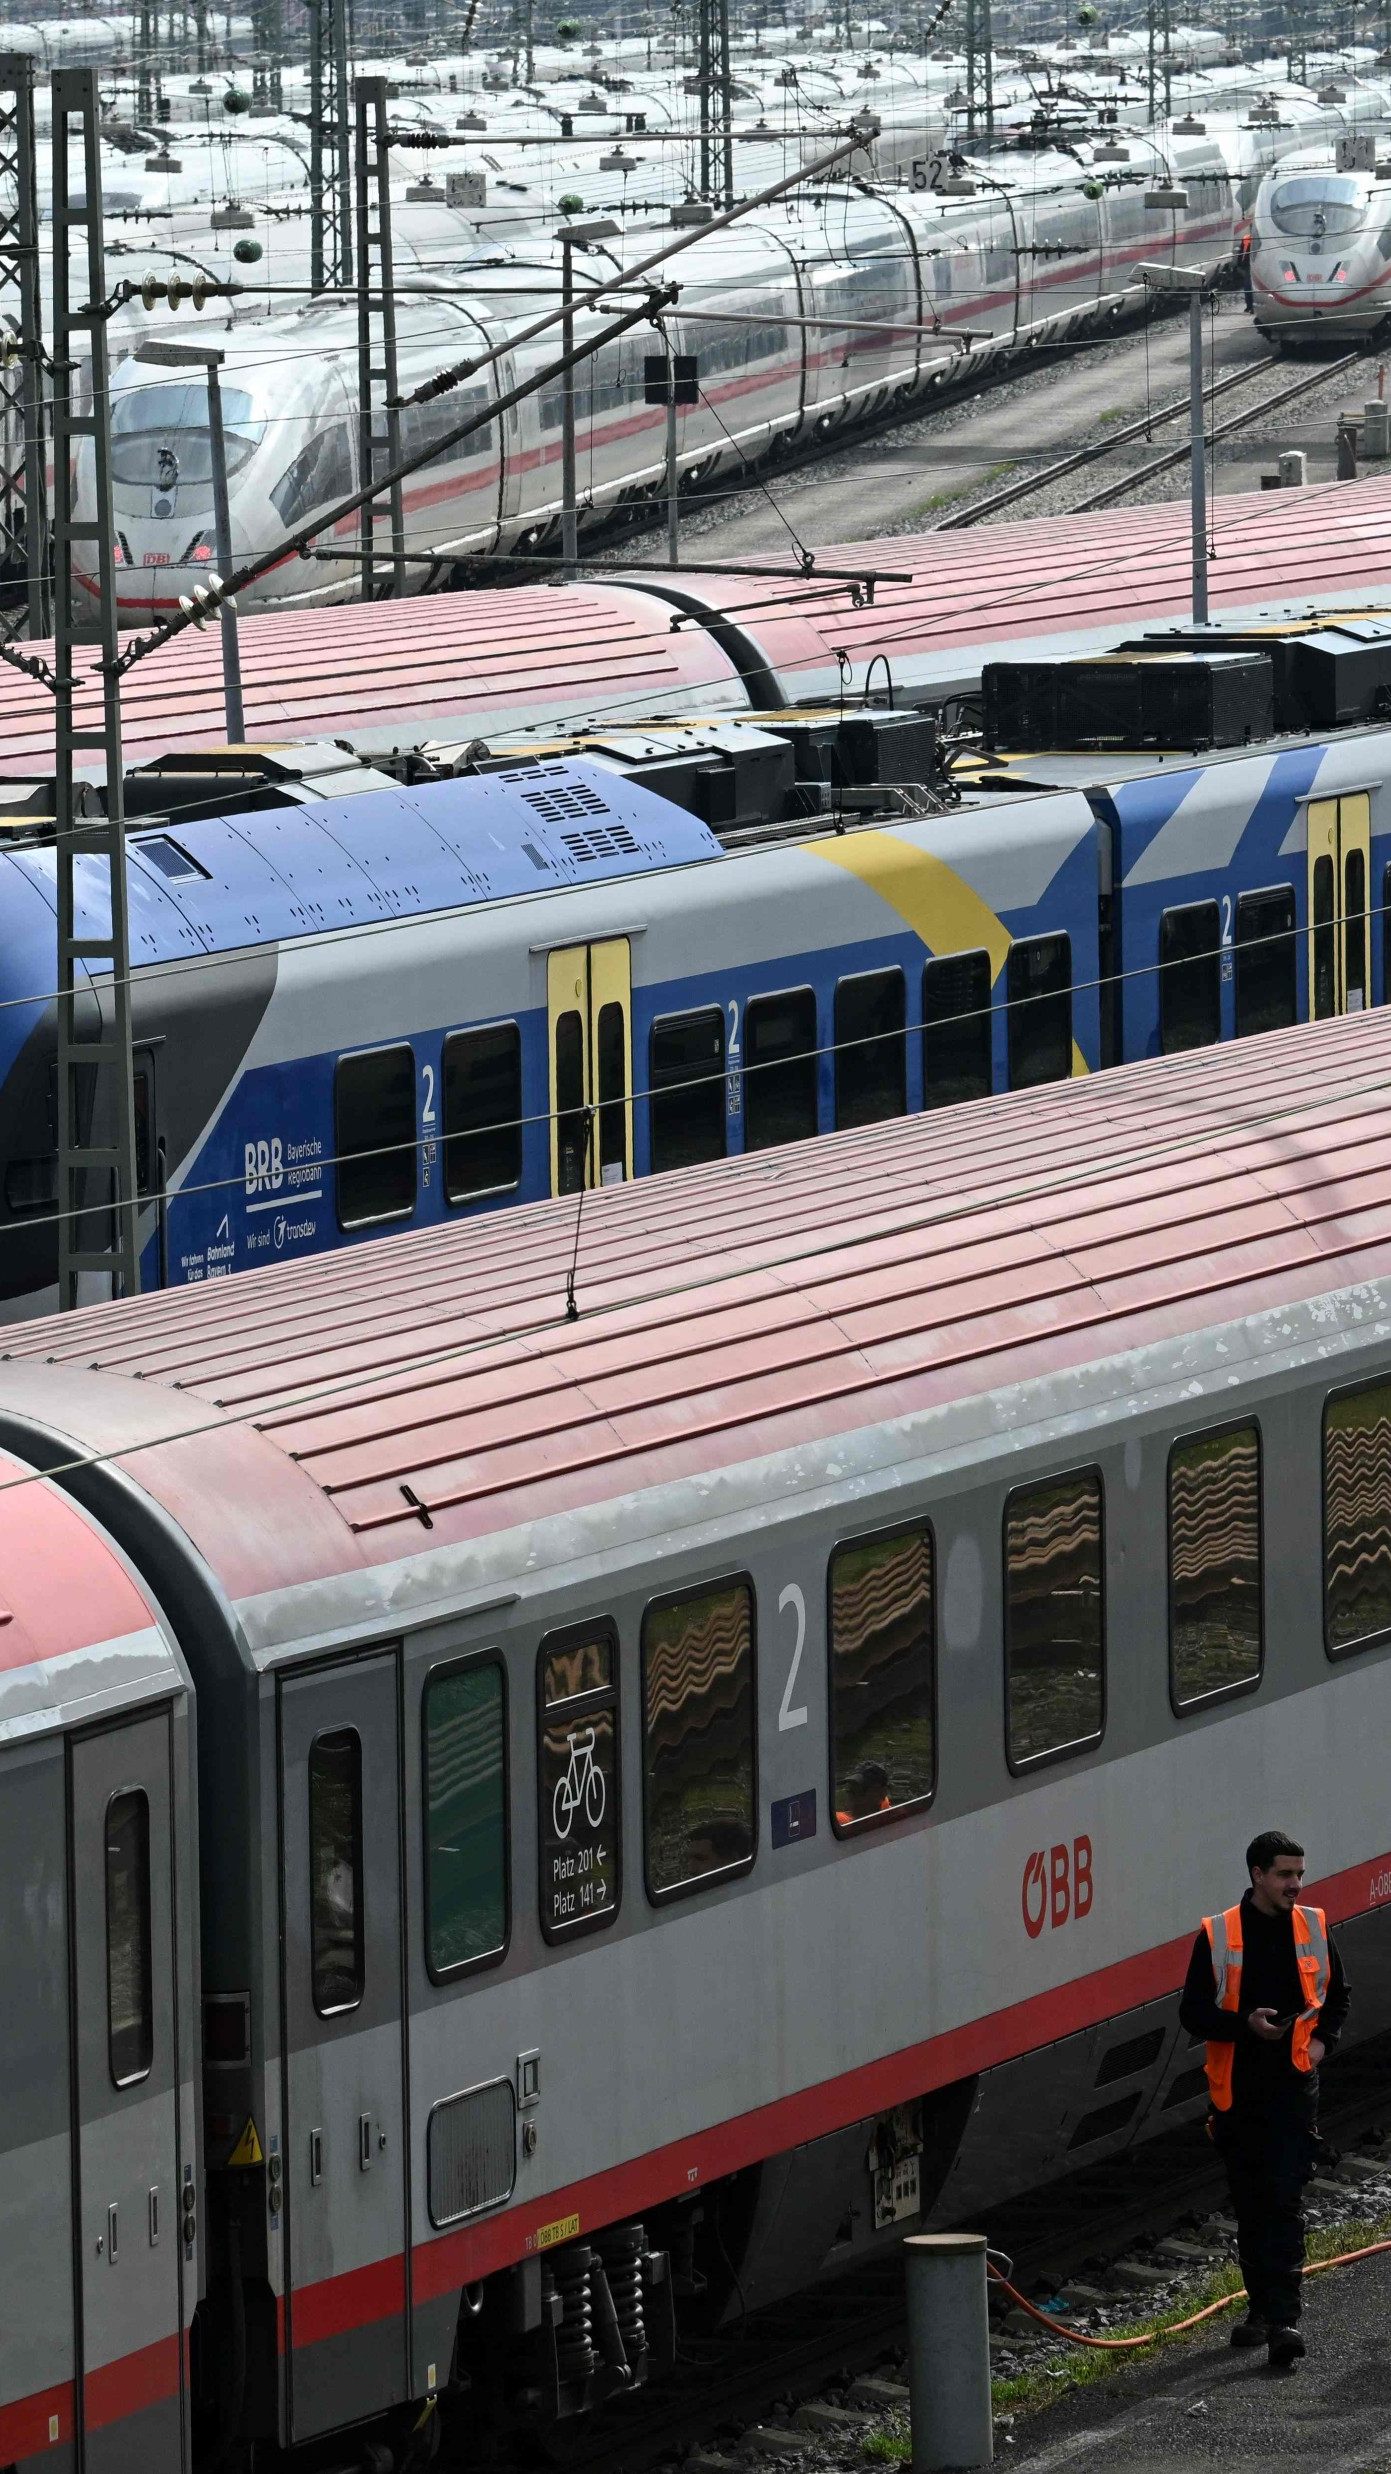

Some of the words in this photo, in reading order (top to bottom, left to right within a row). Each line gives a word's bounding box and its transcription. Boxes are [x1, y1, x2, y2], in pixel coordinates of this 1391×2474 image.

[912, 160, 943, 190] 52
[1222, 894, 1232, 946] 2
[728, 999, 740, 1055] 2
[422, 1064, 436, 1123] 2
[244, 1137, 284, 1195] BRB
[287, 1136, 322, 1164] Bayerische
[246, 1235, 258, 1250] Wir
[258, 1229, 271, 1247] sind
[287, 1218, 317, 1240] transdev
[207, 1241, 235, 1262] Bahnland
[779, 1583, 808, 1732] 2
[553, 1856, 575, 1882] Platz
[578, 1846, 593, 1874] 201
[553, 1891, 576, 1917] Platz
[579, 1882, 594, 1908] 141
[1022, 1834, 1094, 1939] ÖBB
